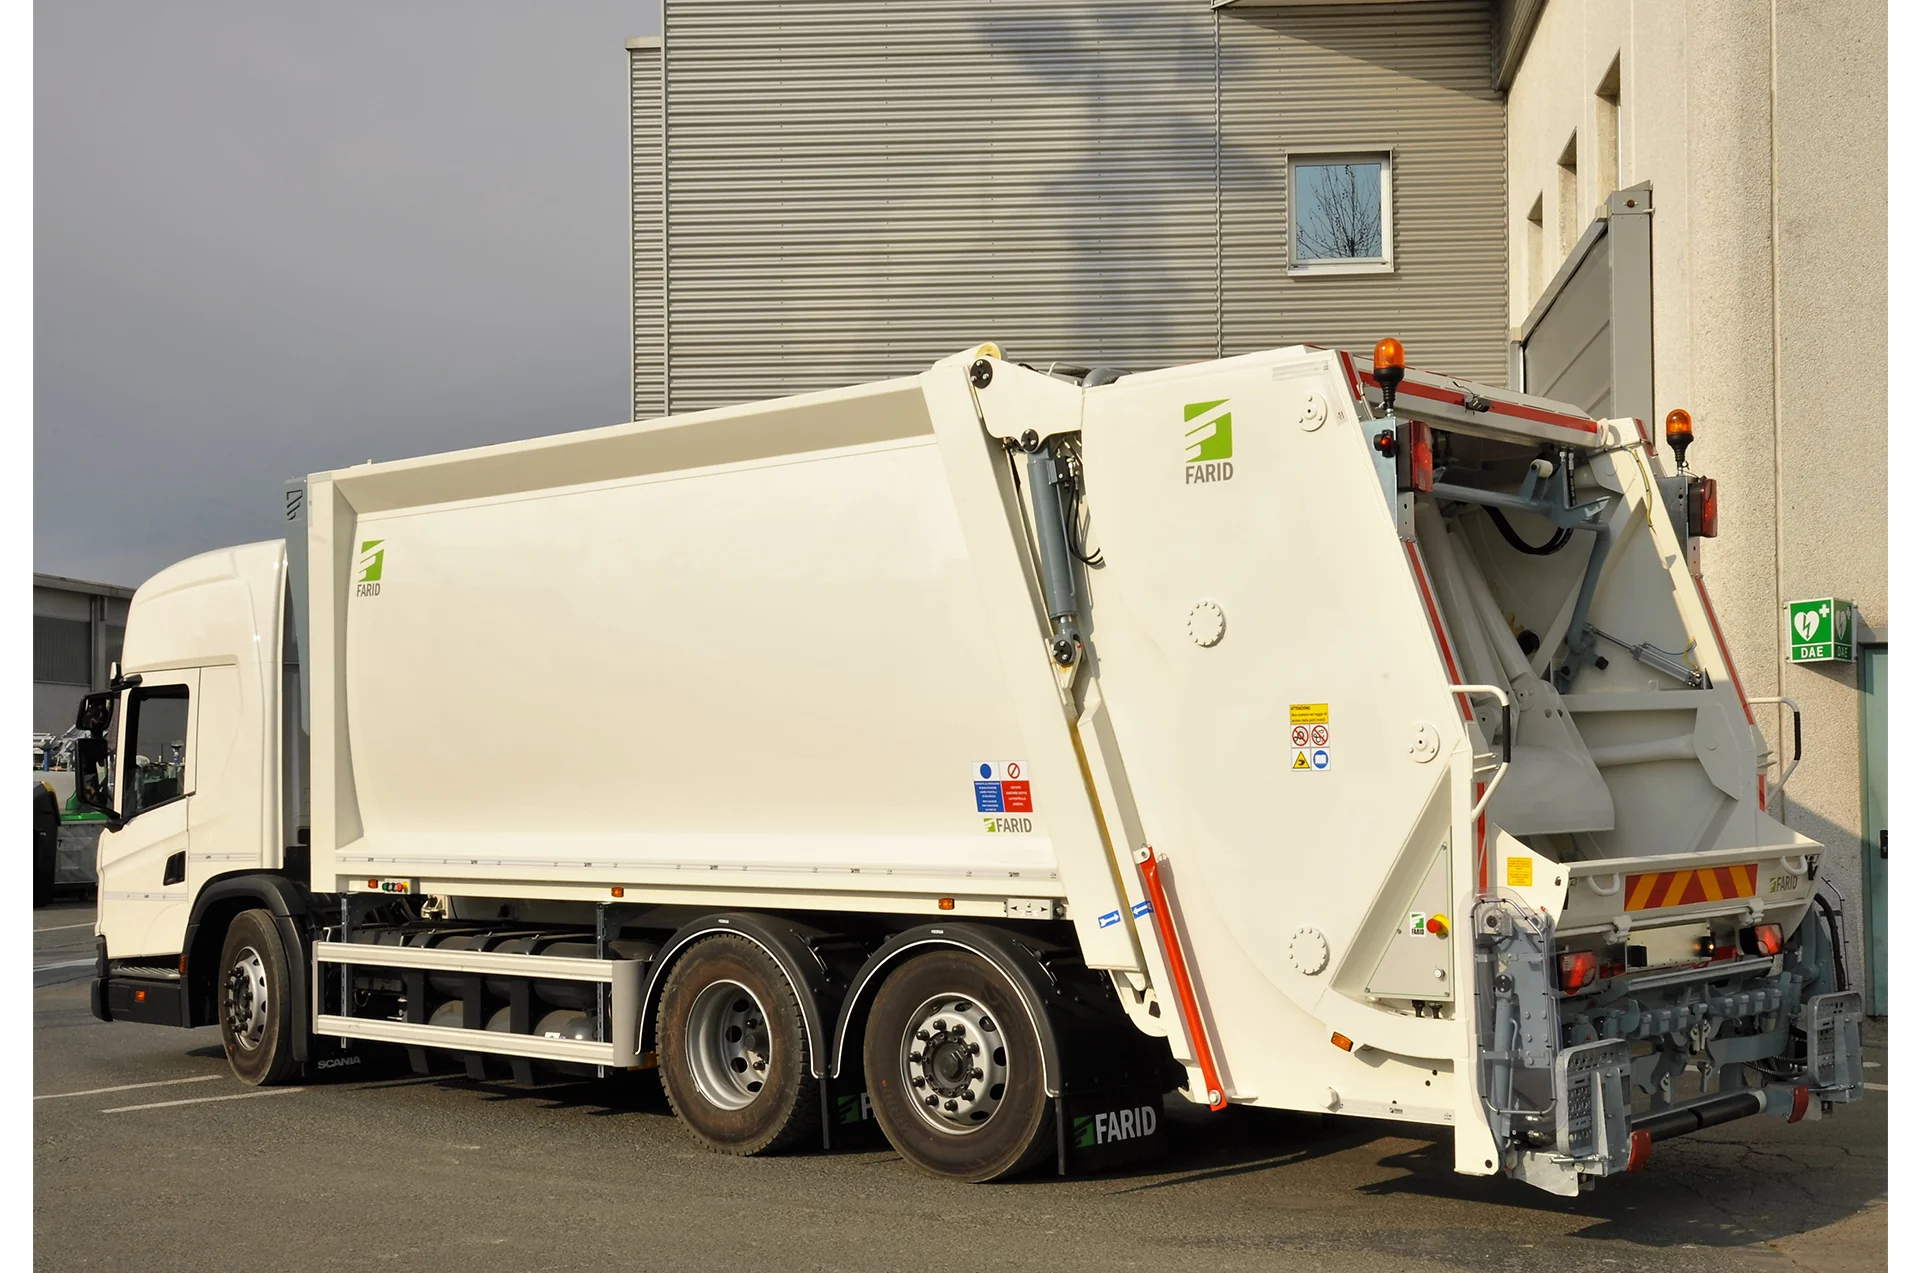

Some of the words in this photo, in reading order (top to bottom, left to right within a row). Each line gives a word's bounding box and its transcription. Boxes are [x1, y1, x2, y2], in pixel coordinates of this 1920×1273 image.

[1185, 462, 1234, 484] FARID
[356, 583, 381, 597] FARID
[1801, 646, 1824, 658] DAE
[996, 818, 1032, 832] FARID
[1776, 875, 1798, 892] FARID
[317, 1056, 361, 1069] SCANIA
[1095, 1106, 1156, 1144] FARID
